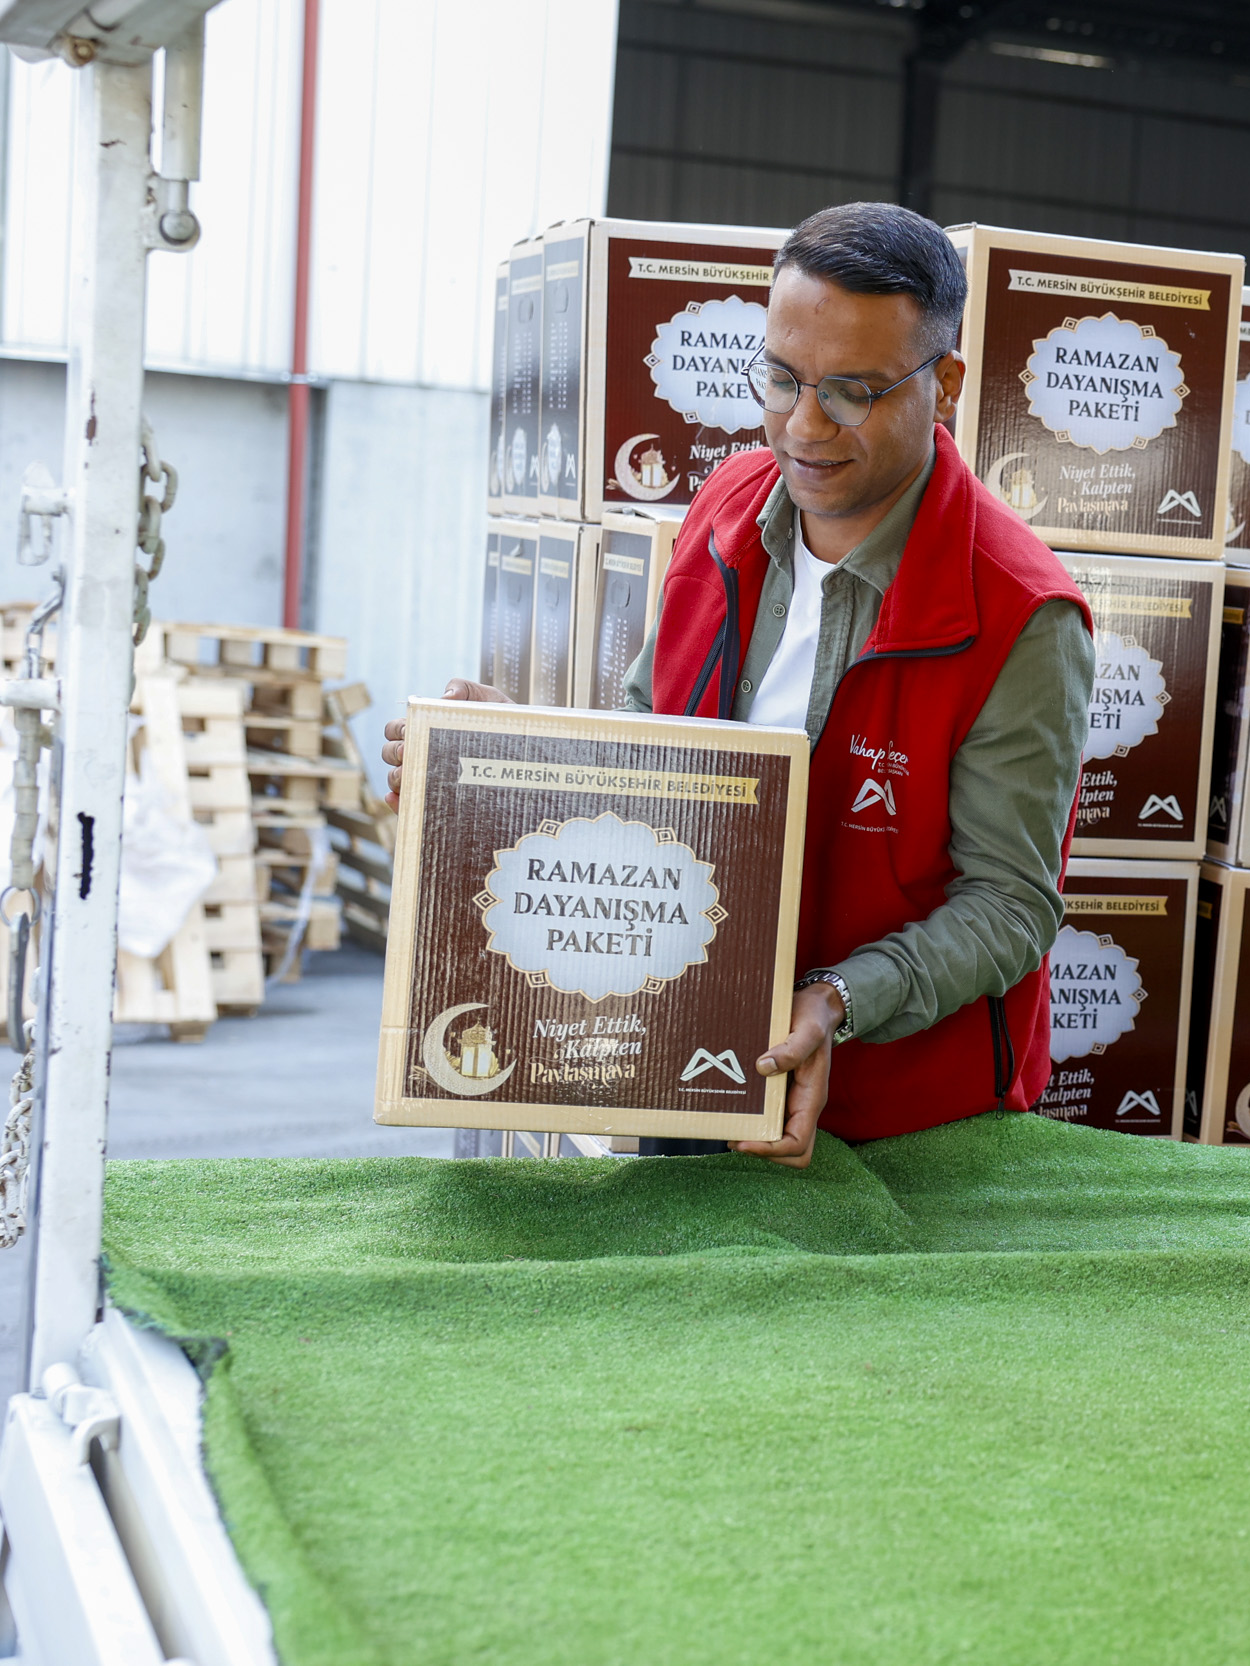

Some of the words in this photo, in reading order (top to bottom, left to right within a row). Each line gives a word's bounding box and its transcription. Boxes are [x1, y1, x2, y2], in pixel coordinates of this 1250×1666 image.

[638, 263, 656, 274] T.C.
[658, 263, 700, 277] MERSİN
[702, 266, 769, 281] BÜYÜKŞEHİR
[1016, 276, 1035, 287] T.C.
[1036, 276, 1077, 291] MERSİN
[1080, 280, 1145, 299] BÜYÜKŞEHİR
[1148, 289, 1203, 306] BELEDİYESİ
[1055, 346, 1160, 373] RAMAZAN
[696, 380, 748, 399] PAKE
[1046, 371, 1164, 403] DAYANIŞMA
[1068, 399, 1140, 422] PAKETİ
[689, 444, 727, 462] Niyet
[1059, 465, 1096, 483] Niyet
[1099, 463, 1136, 480] Ettik,
[1081, 480, 1133, 498] Kalpten
[1090, 709, 1121, 730] ETİ
[850, 733, 886, 770] Vahap
[471, 765, 496, 779] T.C.
[500, 767, 560, 783] MERSİN
[564, 764, 661, 792] BÜYÜKŞEHİR
[666, 780, 747, 798] BELEDİYESİ
[1081, 770, 1118, 787] Ettik,
[526, 858, 683, 891] RAMAZAN
[513, 891, 690, 932] DAYANIŞMA
[1106, 899, 1159, 912] BELEDİYESİ
[546, 927, 653, 957] PAKETİ
[1049, 963, 1117, 981] MAZAN
[532, 1018, 587, 1042] Niyet
[591, 1014, 647, 1036] Ettik,
[1051, 1008, 1098, 1029] KETİ
[564, 1037, 642, 1062] Kalpten
[1058, 1068, 1095, 1085] Ettik,
[1040, 1087, 1092, 1105] Kalpten
